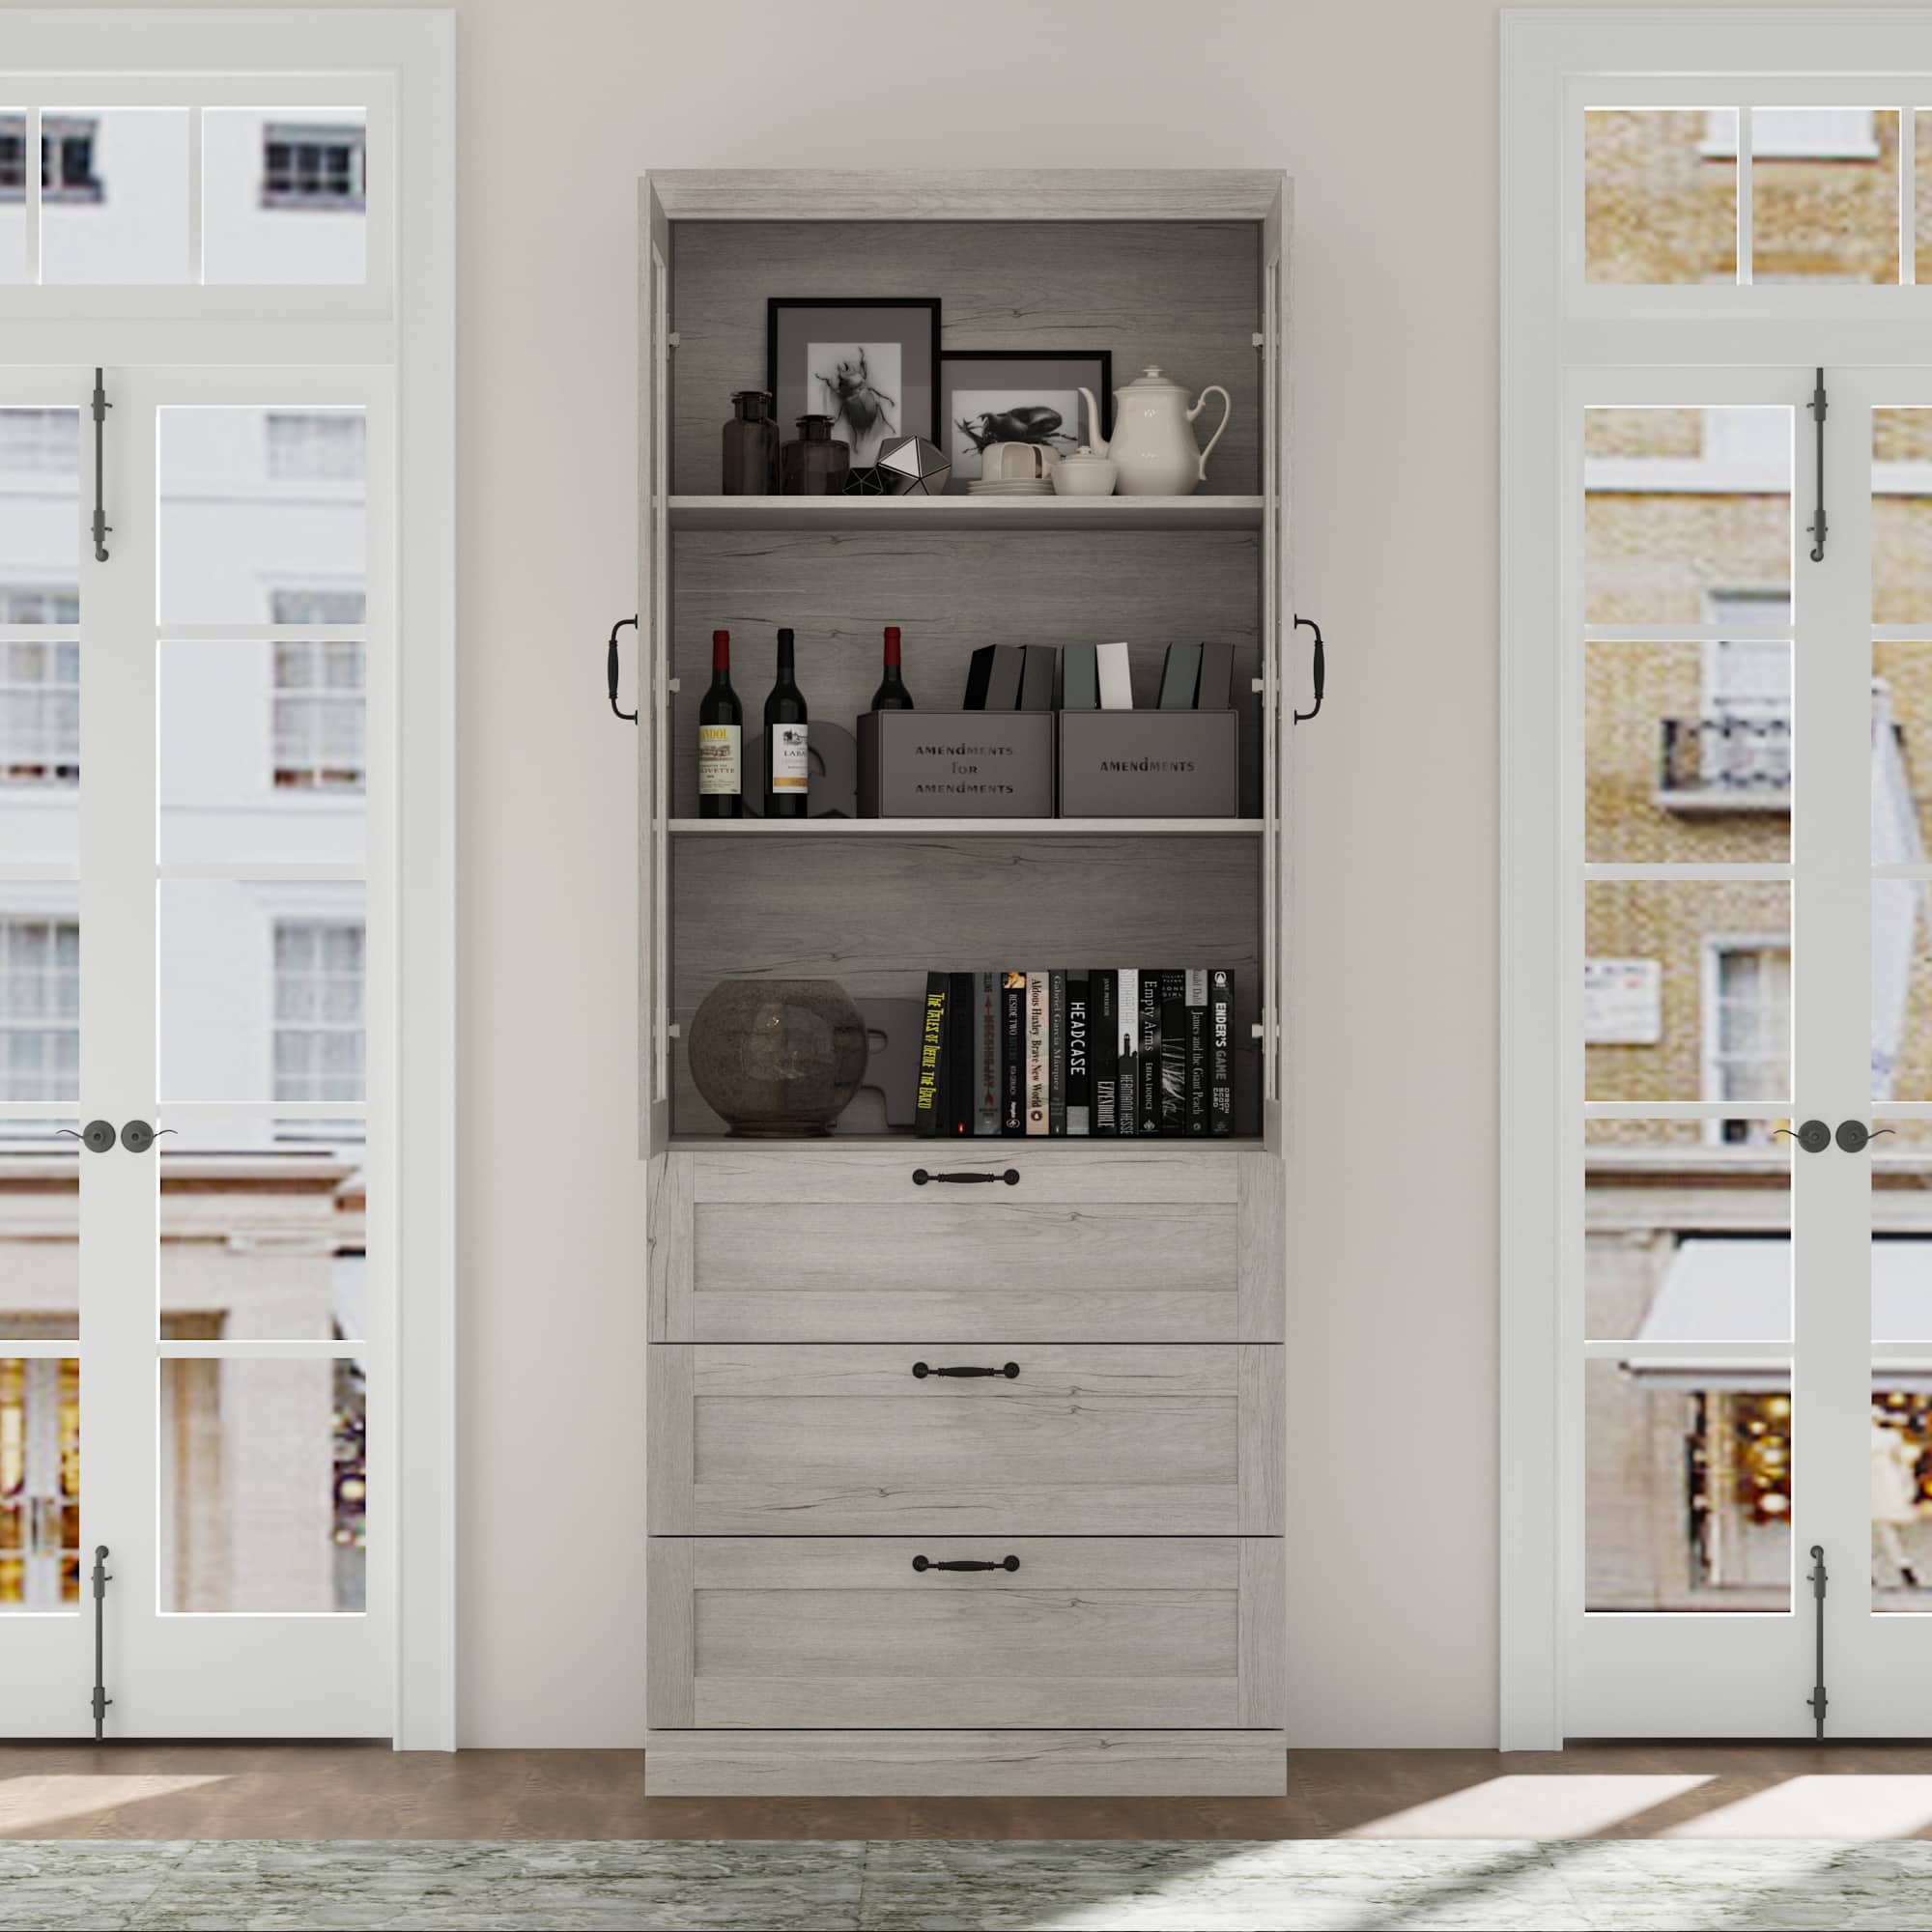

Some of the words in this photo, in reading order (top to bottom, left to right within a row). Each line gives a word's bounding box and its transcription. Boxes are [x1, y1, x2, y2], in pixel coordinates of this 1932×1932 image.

[1031, 979, 1042, 1007] Aldous
[1053, 975, 1063, 1011] Gabriel
[1140, 980, 1157, 1018] Empty
[1009, 994, 1018, 1018] BESIDE
[1009, 1018, 1018, 1037] TWO
[1029, 1009, 1042, 1037] Huxley
[1191, 1010, 1204, 1035] James
[1070, 1002, 1086, 1076] HEADCASE
[1144, 1021, 1157, 1052] Arms
[1192, 1036, 1203, 1051] and
[1031, 1040, 1042, 1064] Brave
[1192, 1053, 1203, 1066] the
[1031, 1065, 1042, 1082] New
[1145, 1062, 1153, 1082] ERIKA
[1215, 1050, 1227, 1080] GAME
[1192, 1067, 1204, 1090] Giant
[1031, 1083, 1042, 1108] World
[1120, 1074, 1134, 1111] HERMANN
[1192, 1092, 1204, 1115] Peach
[1120, 1113, 1134, 1135] HESSE
